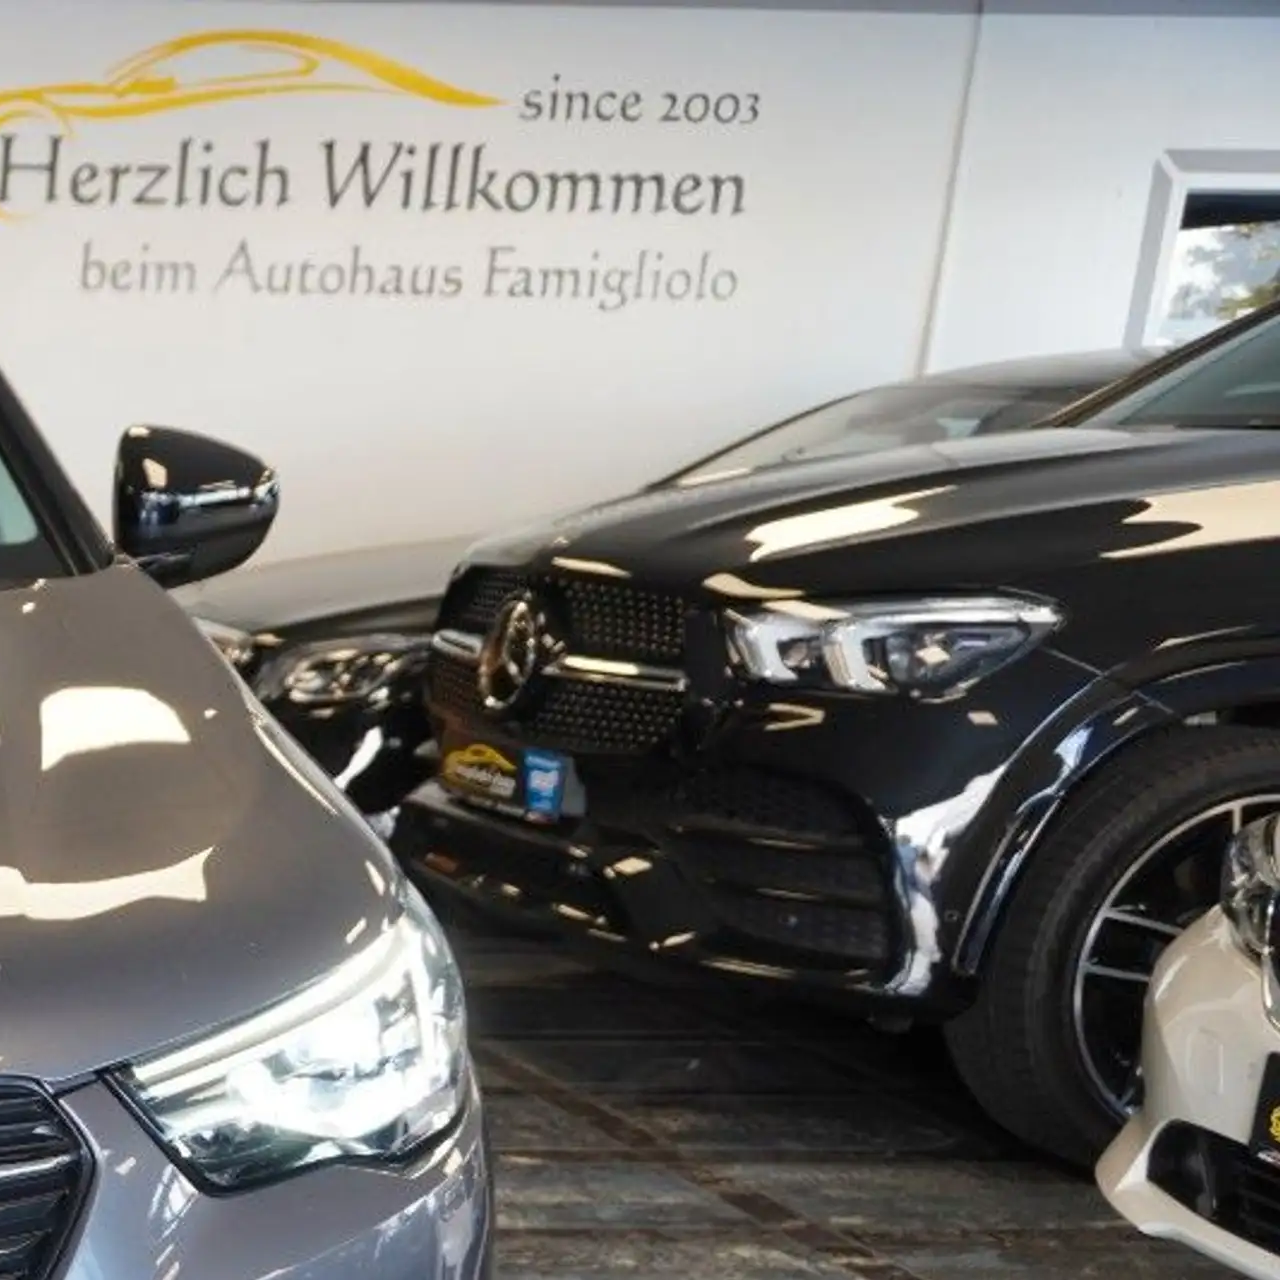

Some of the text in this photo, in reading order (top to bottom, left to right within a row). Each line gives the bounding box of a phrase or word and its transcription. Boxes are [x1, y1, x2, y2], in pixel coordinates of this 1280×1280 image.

[519, 73, 760, 125] since 2003
[320, 139, 746, 215] Willkommen
[80, 237, 739, 312] beim Autohaus Famigliolo
